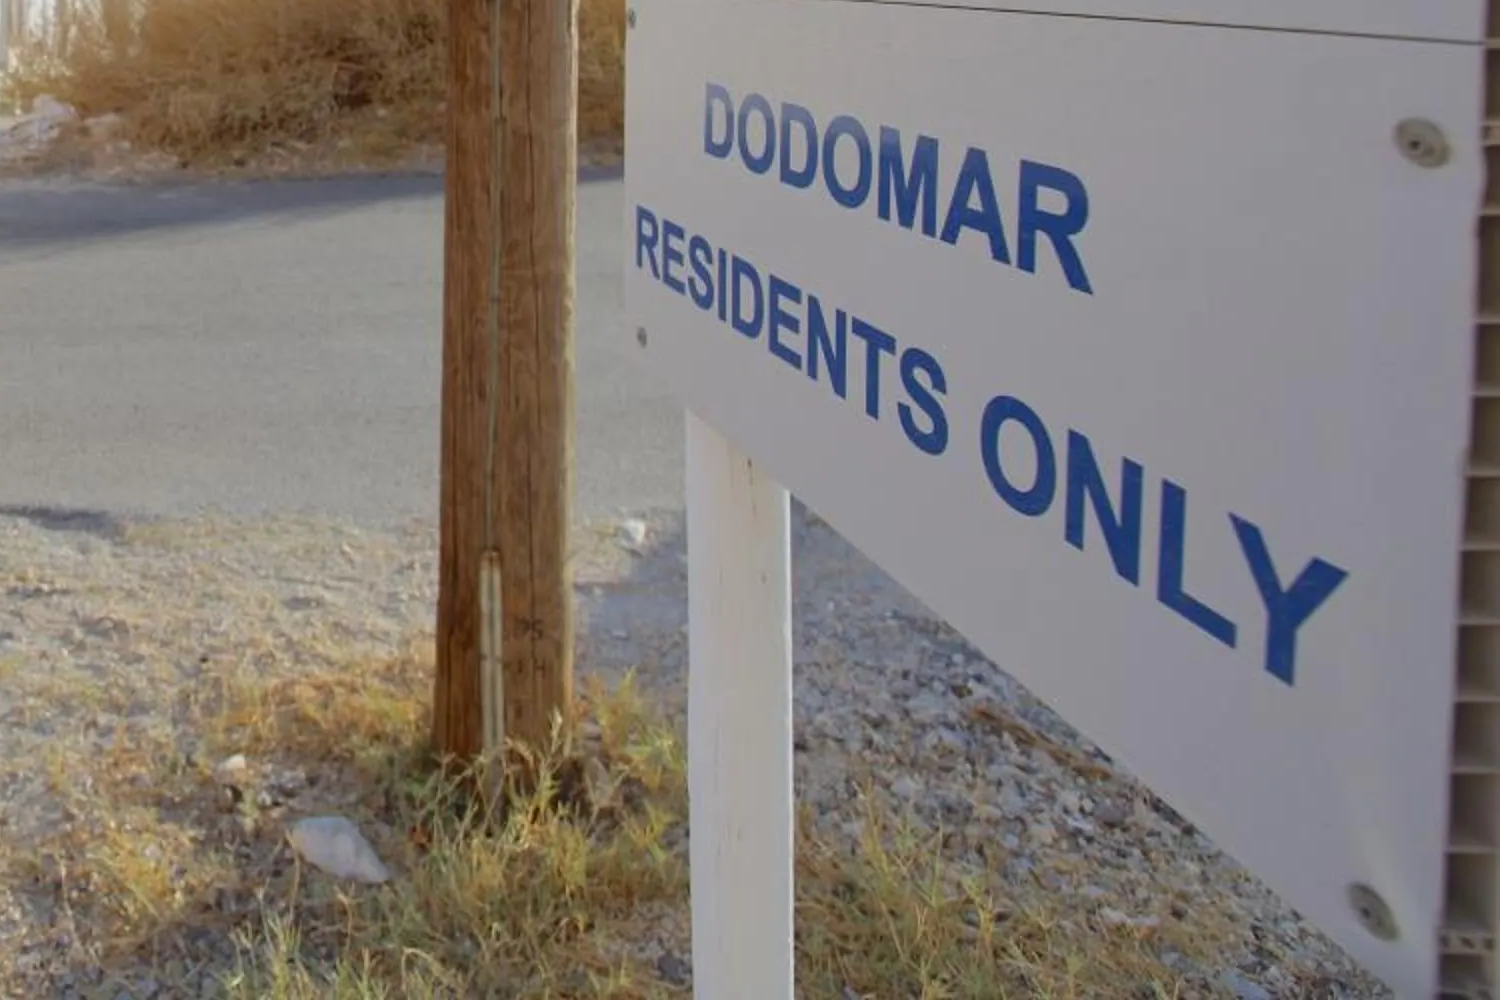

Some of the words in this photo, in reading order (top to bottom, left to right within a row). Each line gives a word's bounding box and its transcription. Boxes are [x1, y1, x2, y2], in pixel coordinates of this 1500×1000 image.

[704, 82, 1094, 296] DODOMAR
[635, 205, 948, 456] RESIDENTS
[981, 395, 1349, 688] ONLY
